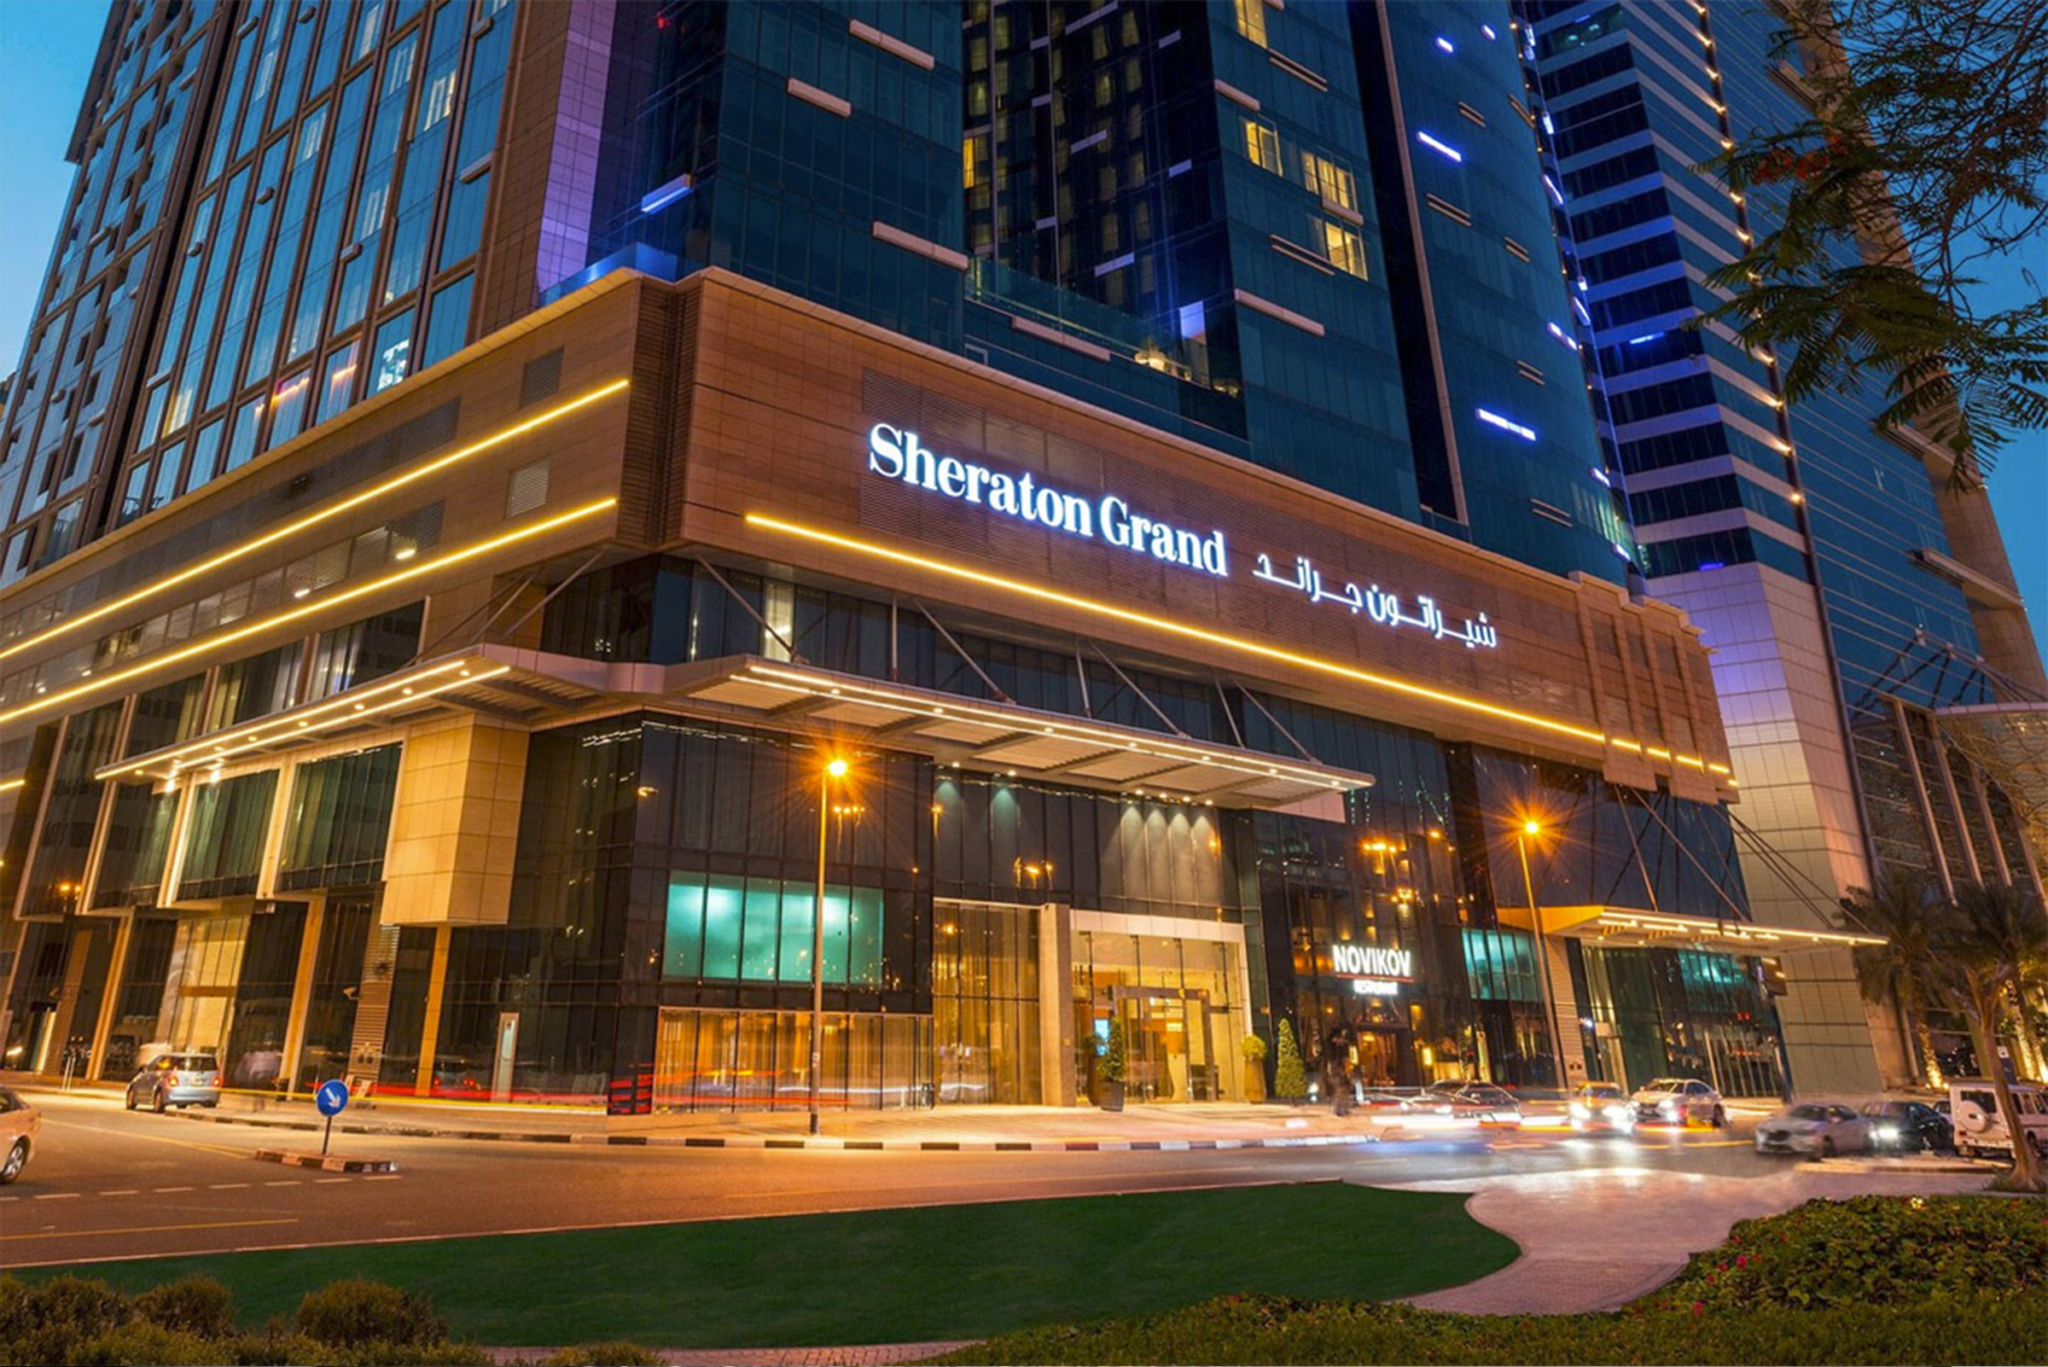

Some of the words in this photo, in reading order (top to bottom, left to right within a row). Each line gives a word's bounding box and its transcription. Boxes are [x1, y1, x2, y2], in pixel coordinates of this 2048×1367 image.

[869, 423, 1094, 537] Sheraton
[1100, 495, 1229, 577] Grand
[1332, 945, 1411, 977] NOVIKOV
